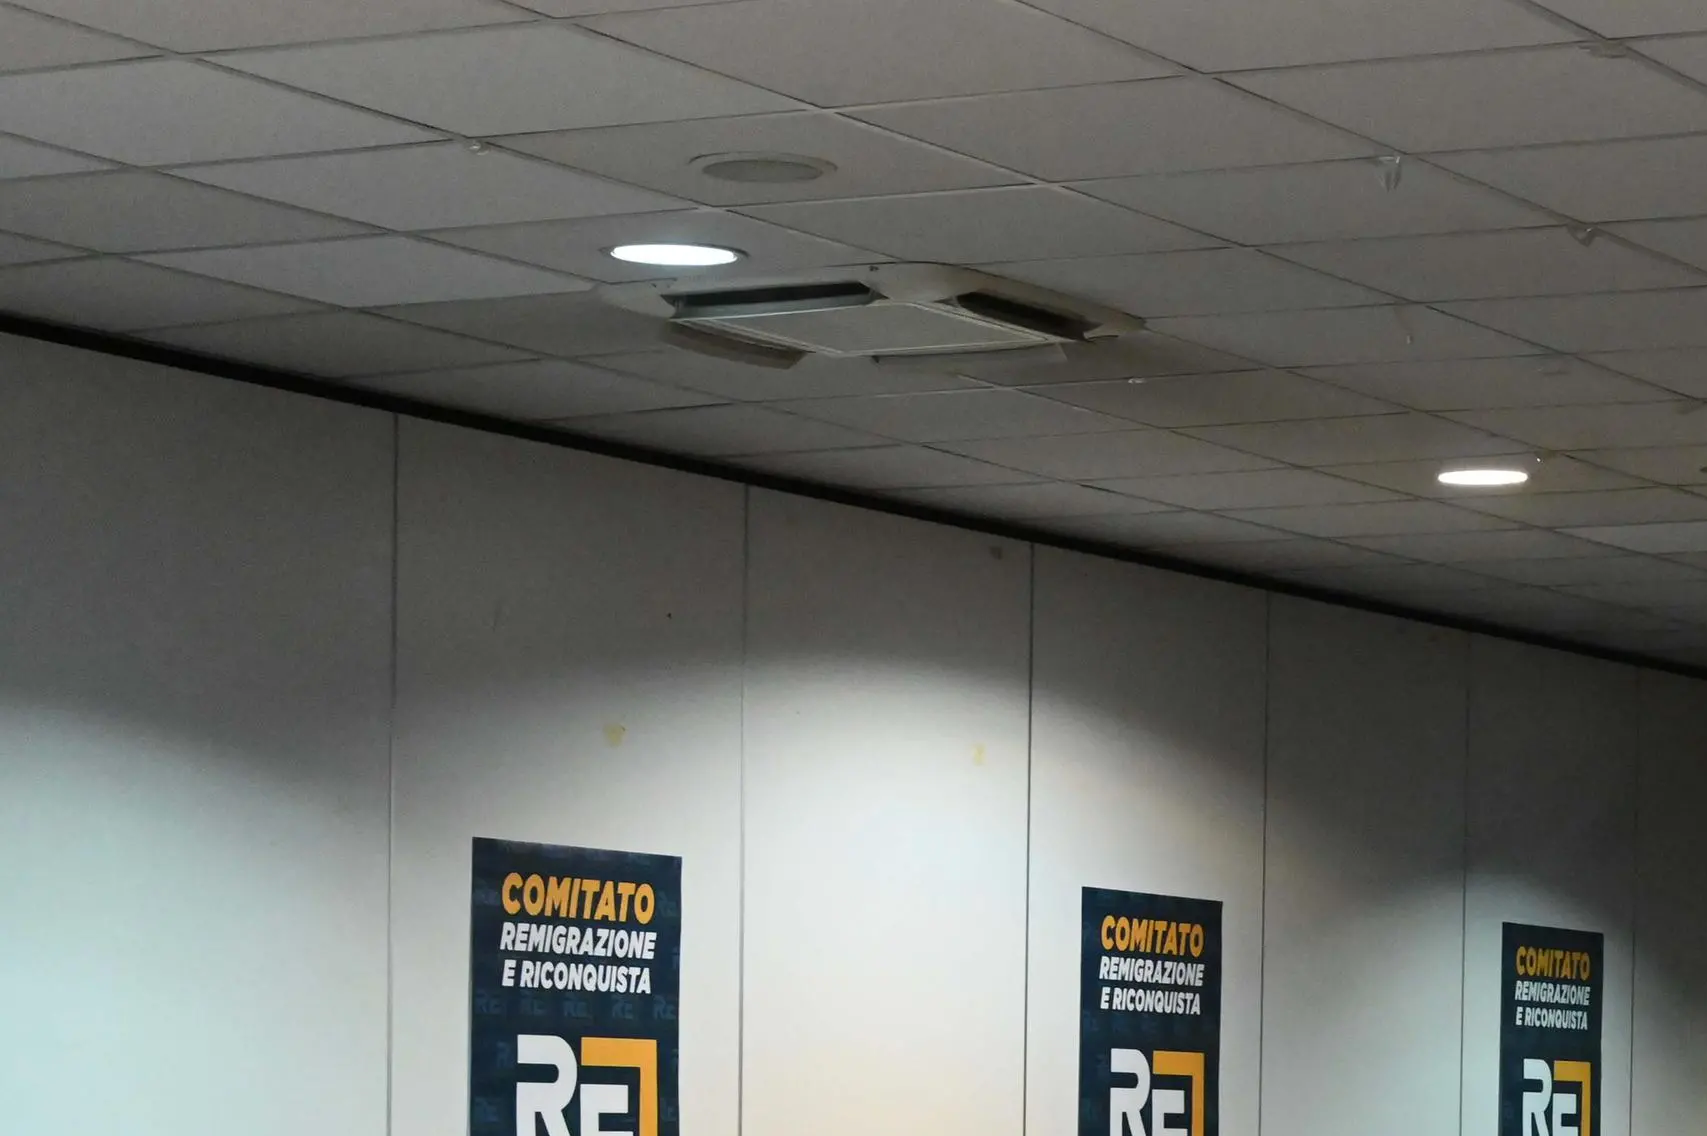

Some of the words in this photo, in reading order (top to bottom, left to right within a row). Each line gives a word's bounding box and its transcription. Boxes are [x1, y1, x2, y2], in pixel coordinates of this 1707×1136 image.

[501, 872, 655, 924] COMITATO
[500, 921, 657, 960] REMIGRAZIONE
[1101, 915, 1204, 957] COMITATO
[501, 959, 517, 987] E
[519, 961, 651, 994] RICONQUISTA
[1099, 956, 1205, 987] REMIGRAZIONE
[1516, 946, 1591, 981] COMITATO
[1100, 986, 1111, 1010] E
[1112, 987, 1201, 1015] RICONQUISTA
[1515, 980, 1591, 1006] REMIGRAZIONE
[1516, 1006, 1523, 1026] E
[1524, 1007, 1588, 1031] RICONQUISTA
